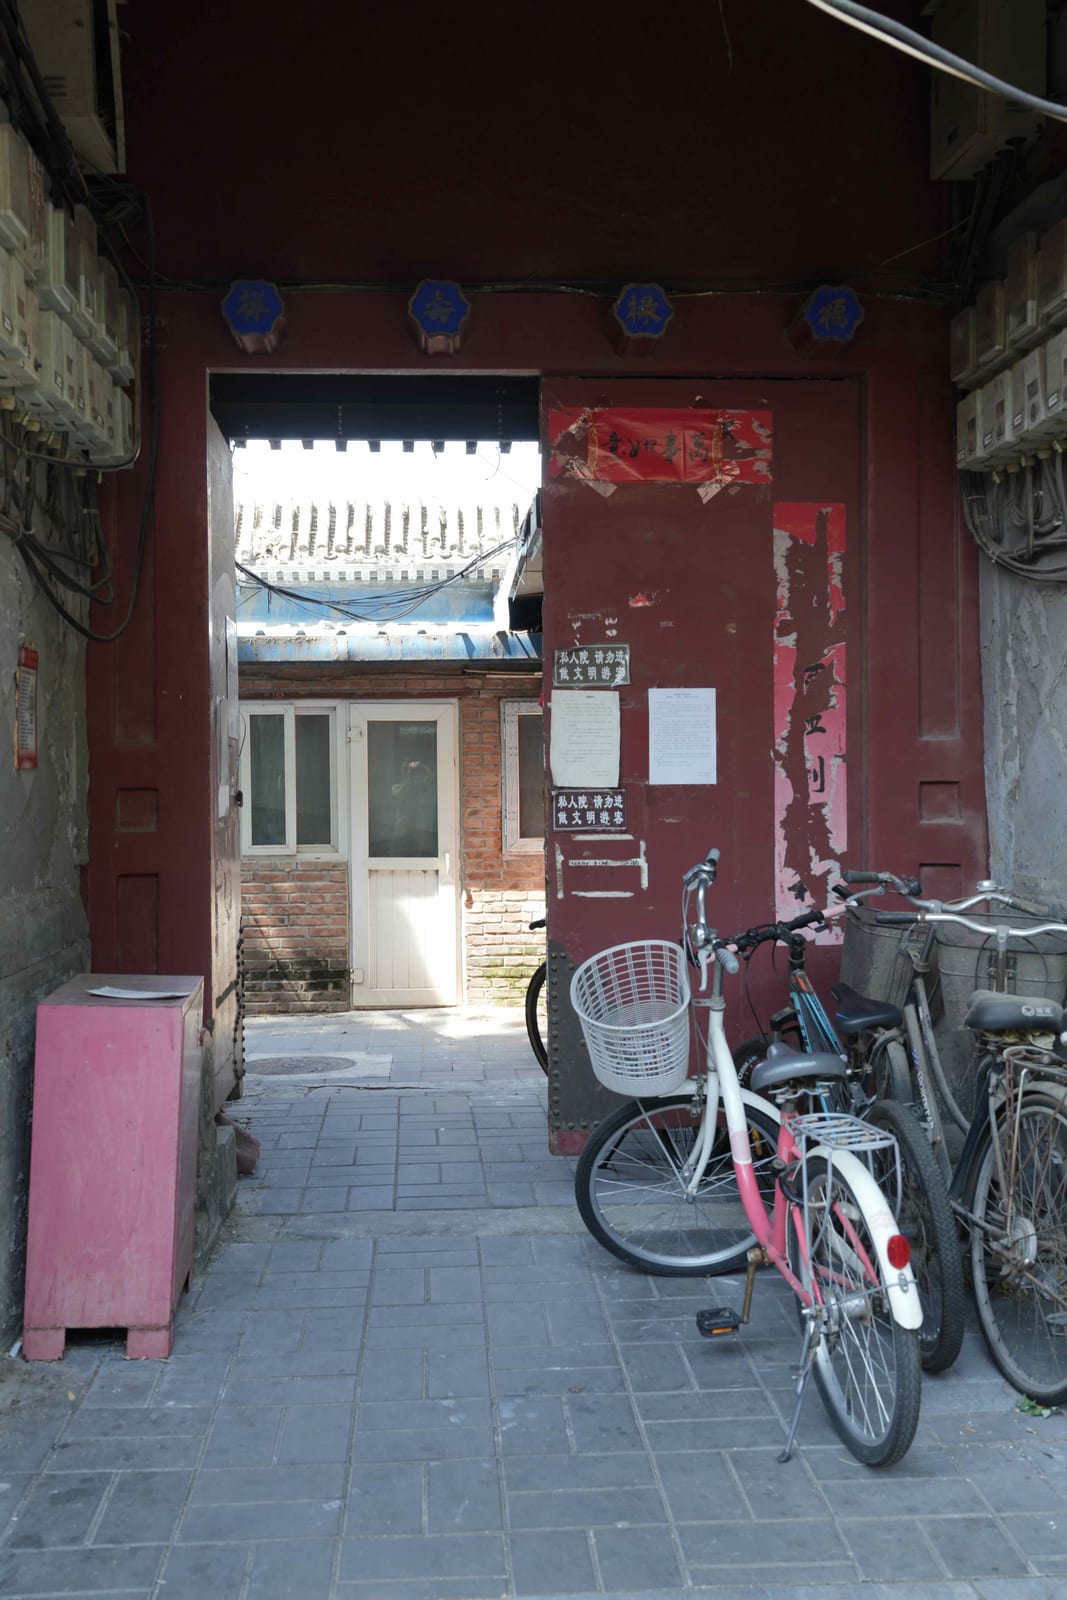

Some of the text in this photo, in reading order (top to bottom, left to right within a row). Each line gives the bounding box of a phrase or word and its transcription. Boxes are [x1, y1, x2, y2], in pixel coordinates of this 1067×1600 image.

[817, 297, 849, 332] 福
[559, 650, 590, 665] 私人院
[557, 795, 624, 809] 私人院 请勿进
